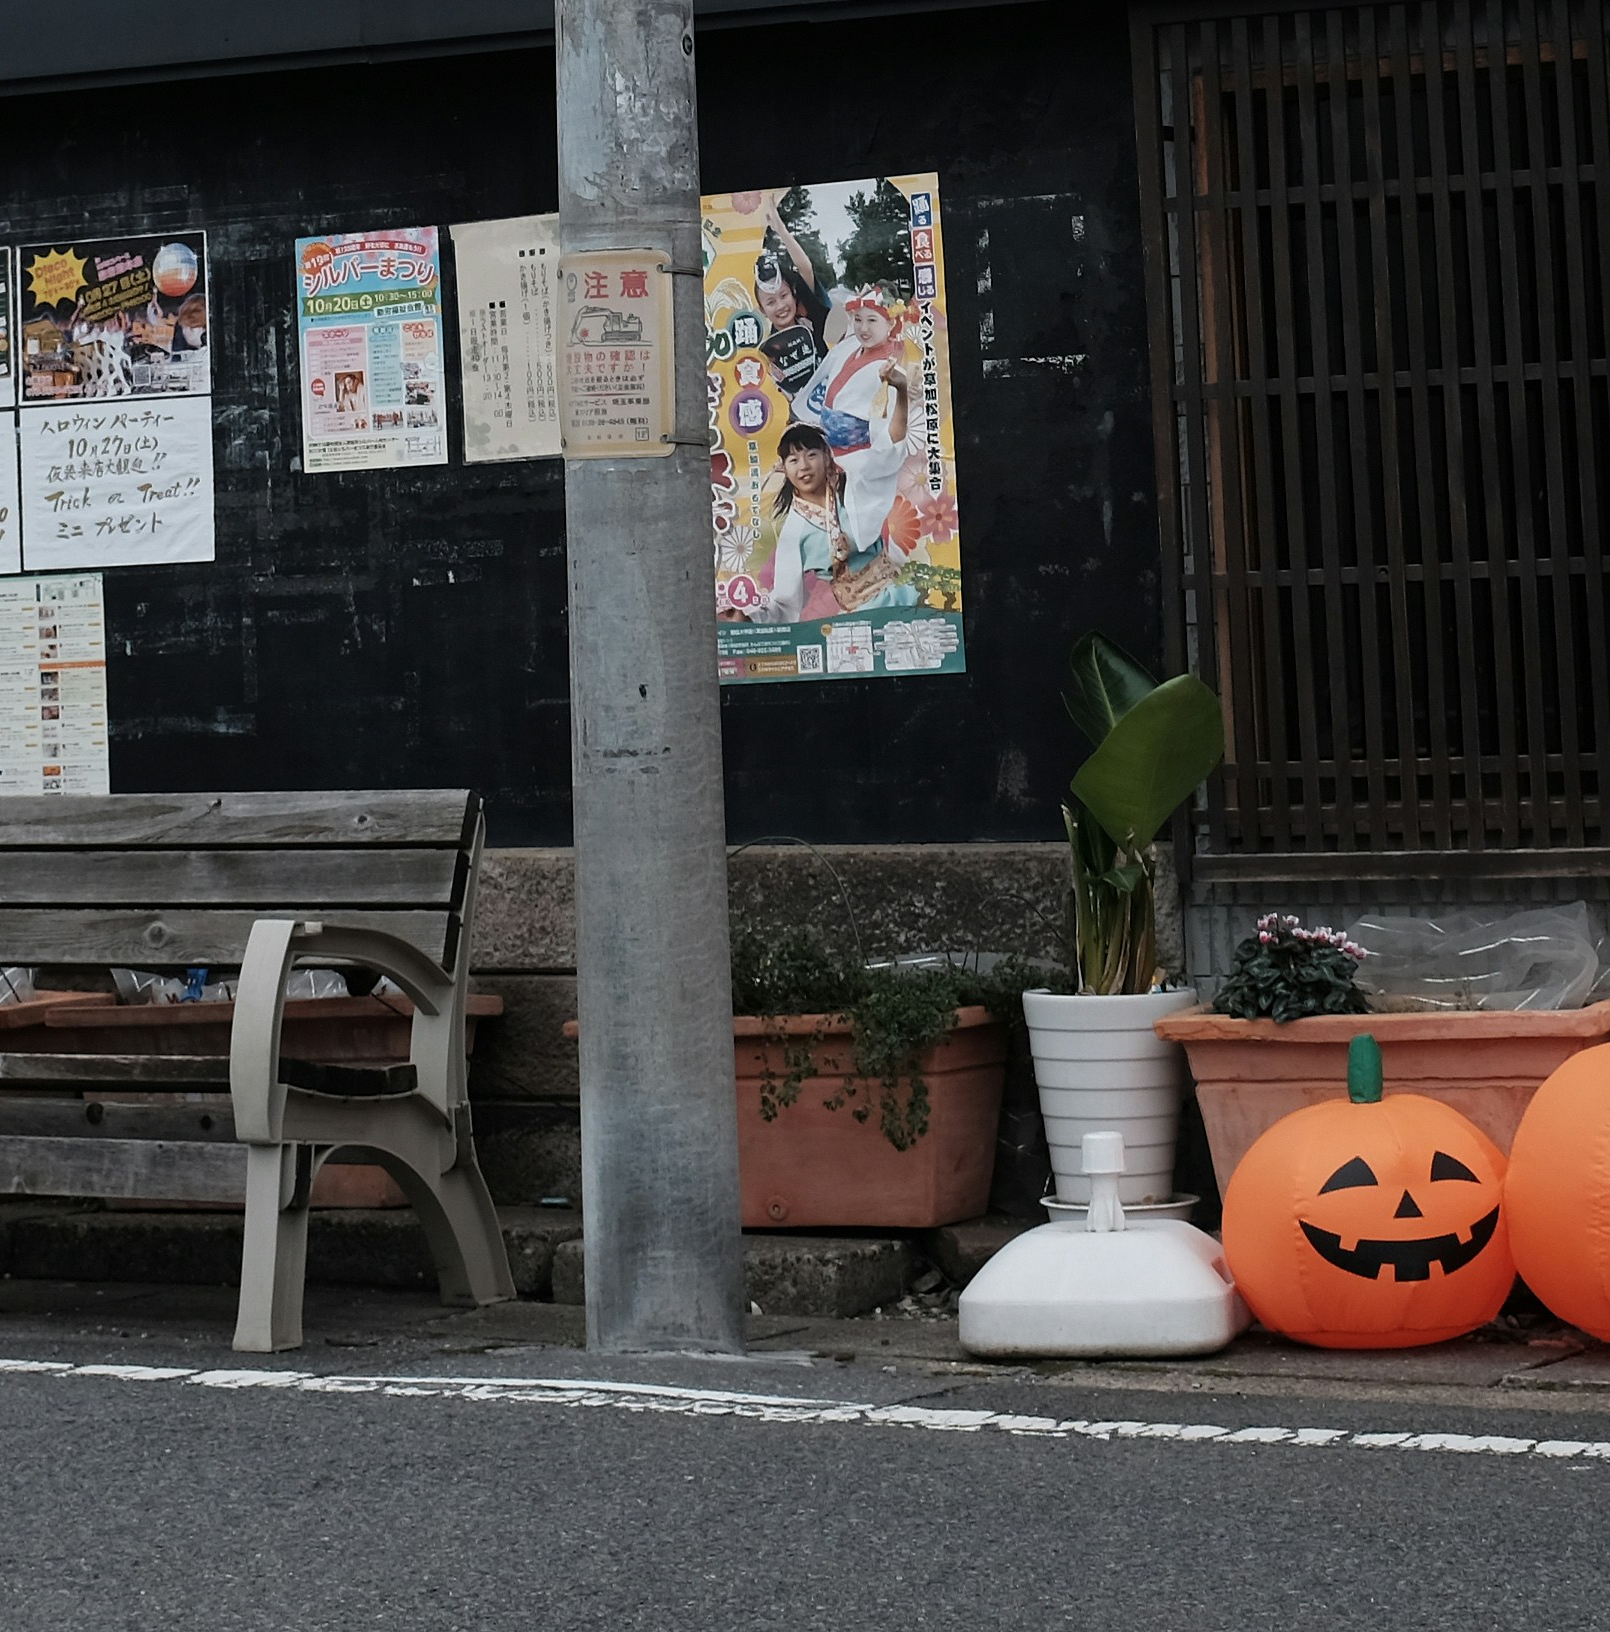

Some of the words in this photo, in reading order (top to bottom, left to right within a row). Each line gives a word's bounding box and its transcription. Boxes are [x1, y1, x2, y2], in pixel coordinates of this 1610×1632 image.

[914, 231, 933, 259] 食べる
[303, 256, 435, 297] シルバーまつり
[583, 270, 649, 299] 注意
[736, 358, 761, 386] 食
[920, 300, 942, 492] イベントが草加松原に大集合
[40, 413, 107, 435] ハロウィン
[110, 411, 174, 430] パーティー
[739, 399, 763, 427] 感
[68, 435, 159, 459] 10月27日(土)
[44, 487, 92, 512] Trick
[56, 522, 83, 539] ミニ
[95, 512, 163, 536] プレゼント
